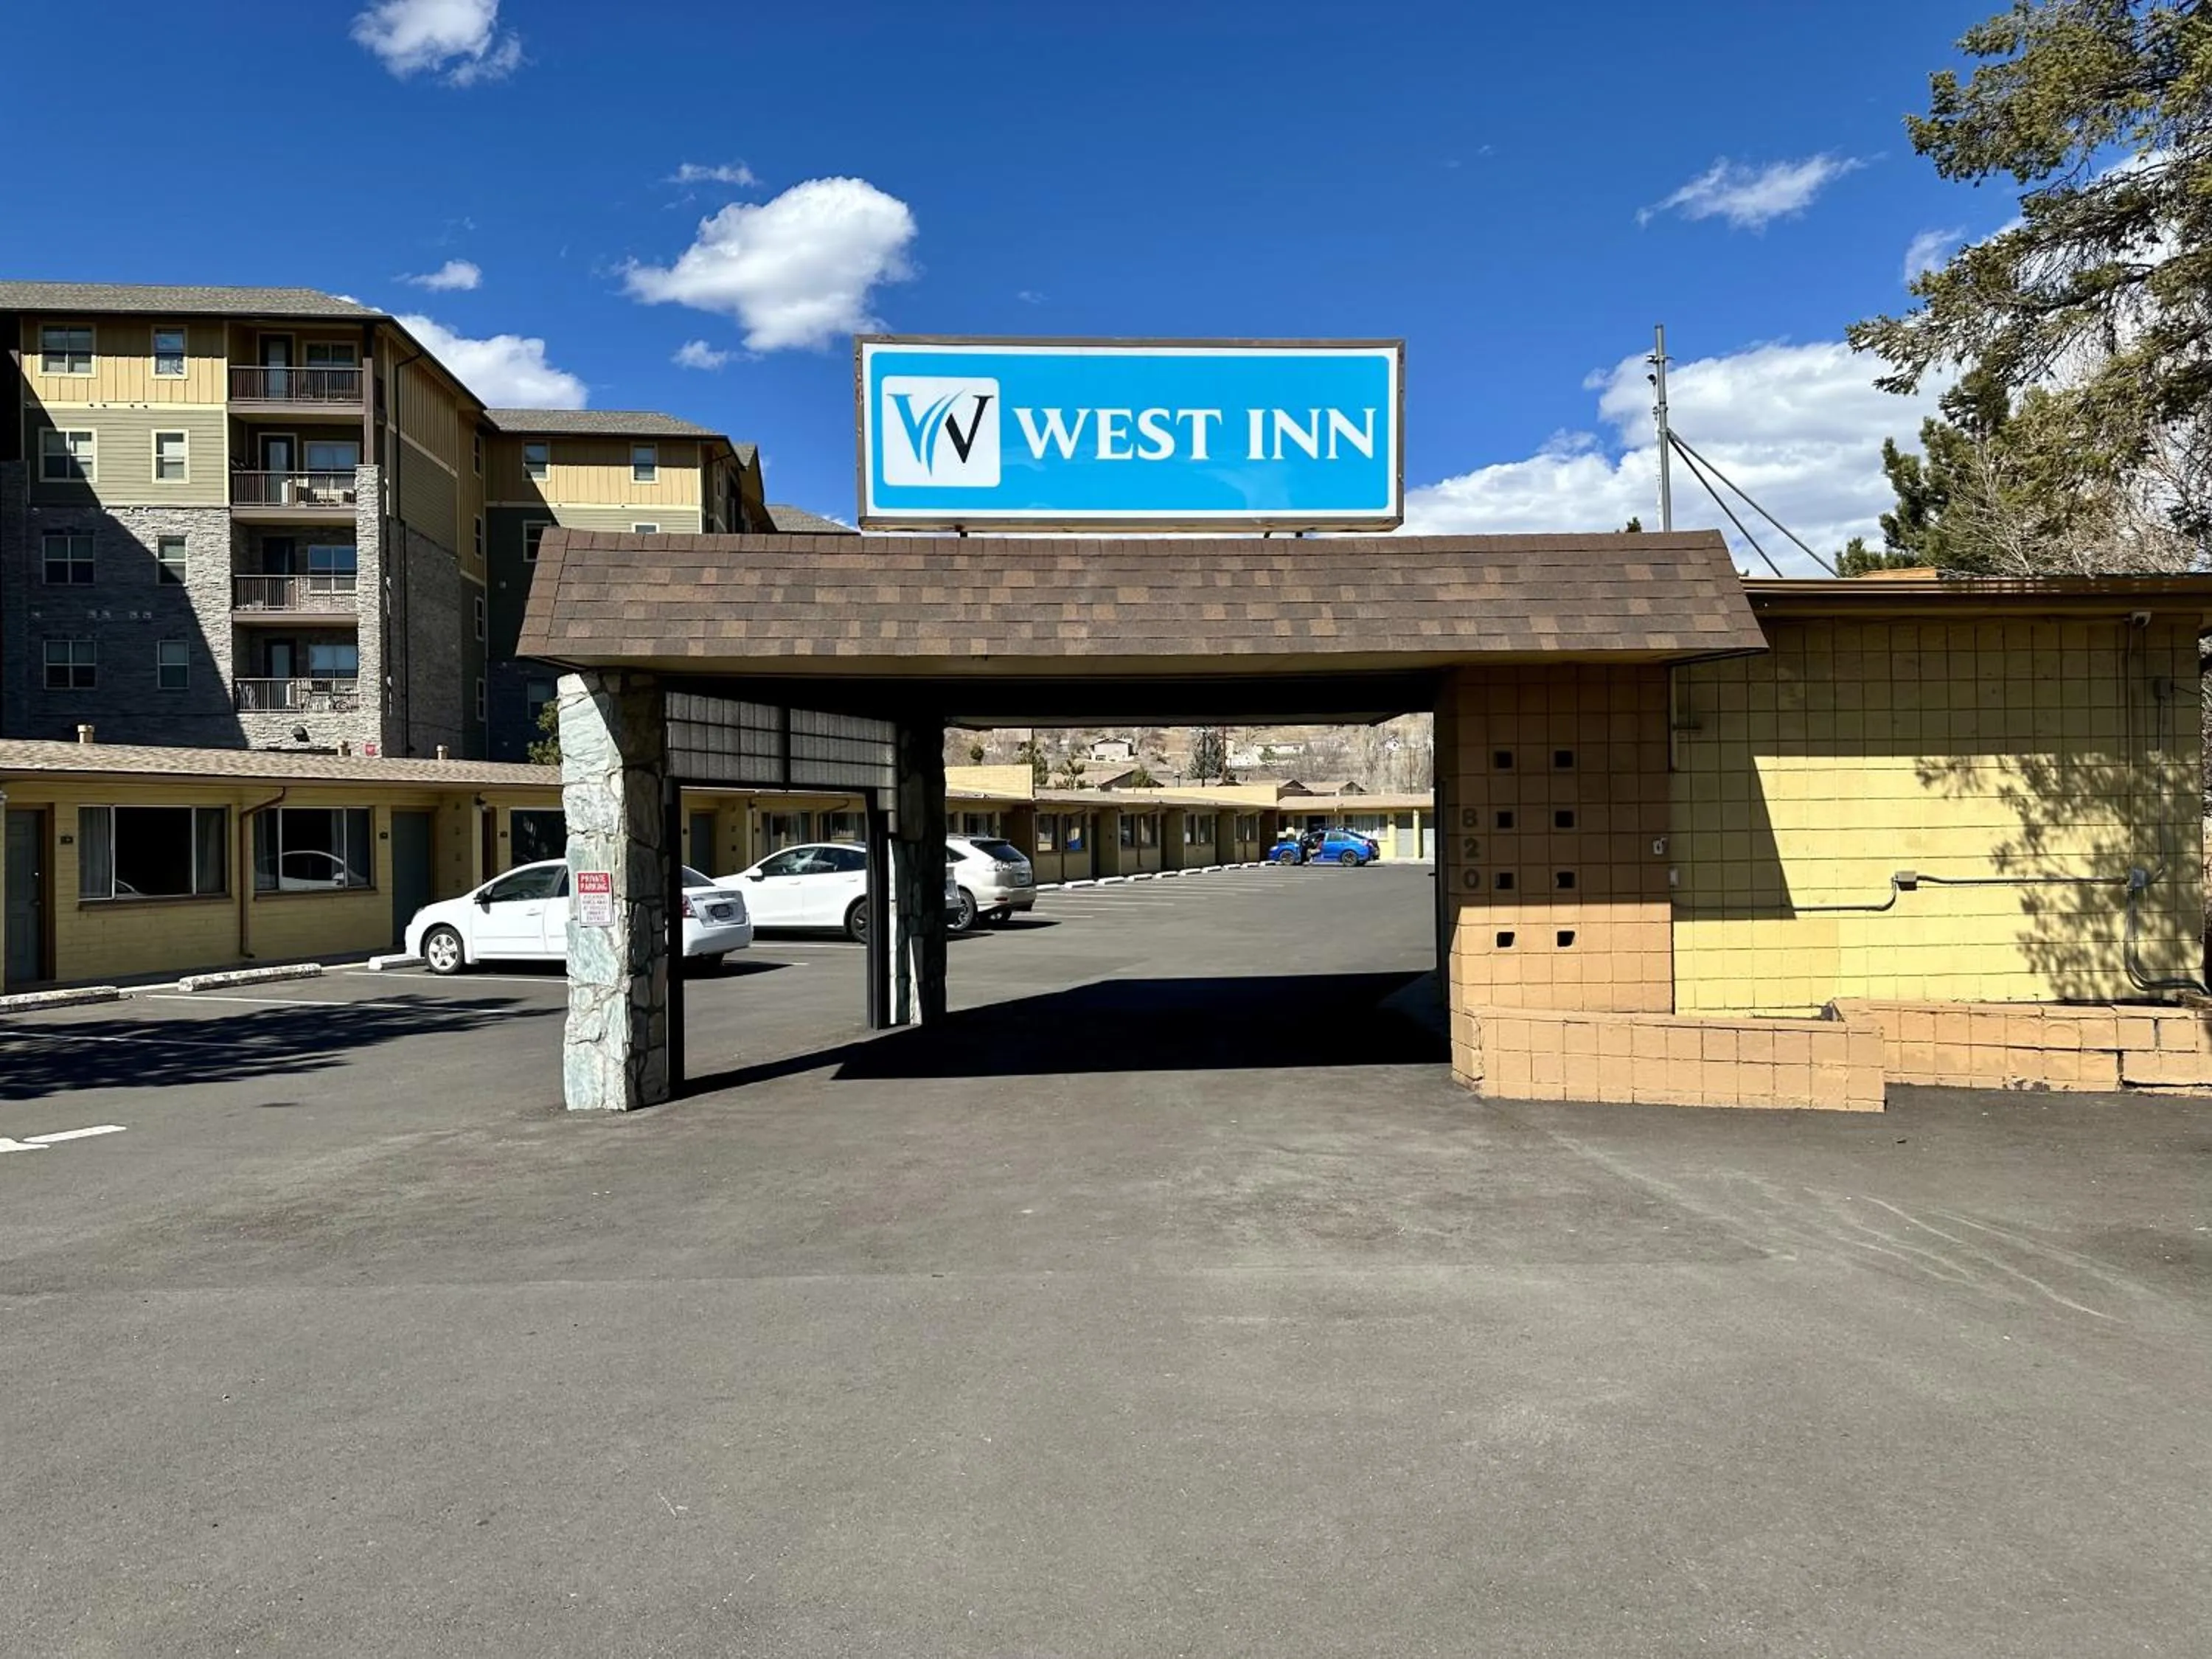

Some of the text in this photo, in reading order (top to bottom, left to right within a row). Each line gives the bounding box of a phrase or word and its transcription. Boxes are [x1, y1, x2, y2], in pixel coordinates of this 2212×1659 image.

[1013, 408, 1377, 460] WEST INN
[580, 874, 606, 883] PRIVATE
[580, 883, 608, 891] PARKING
